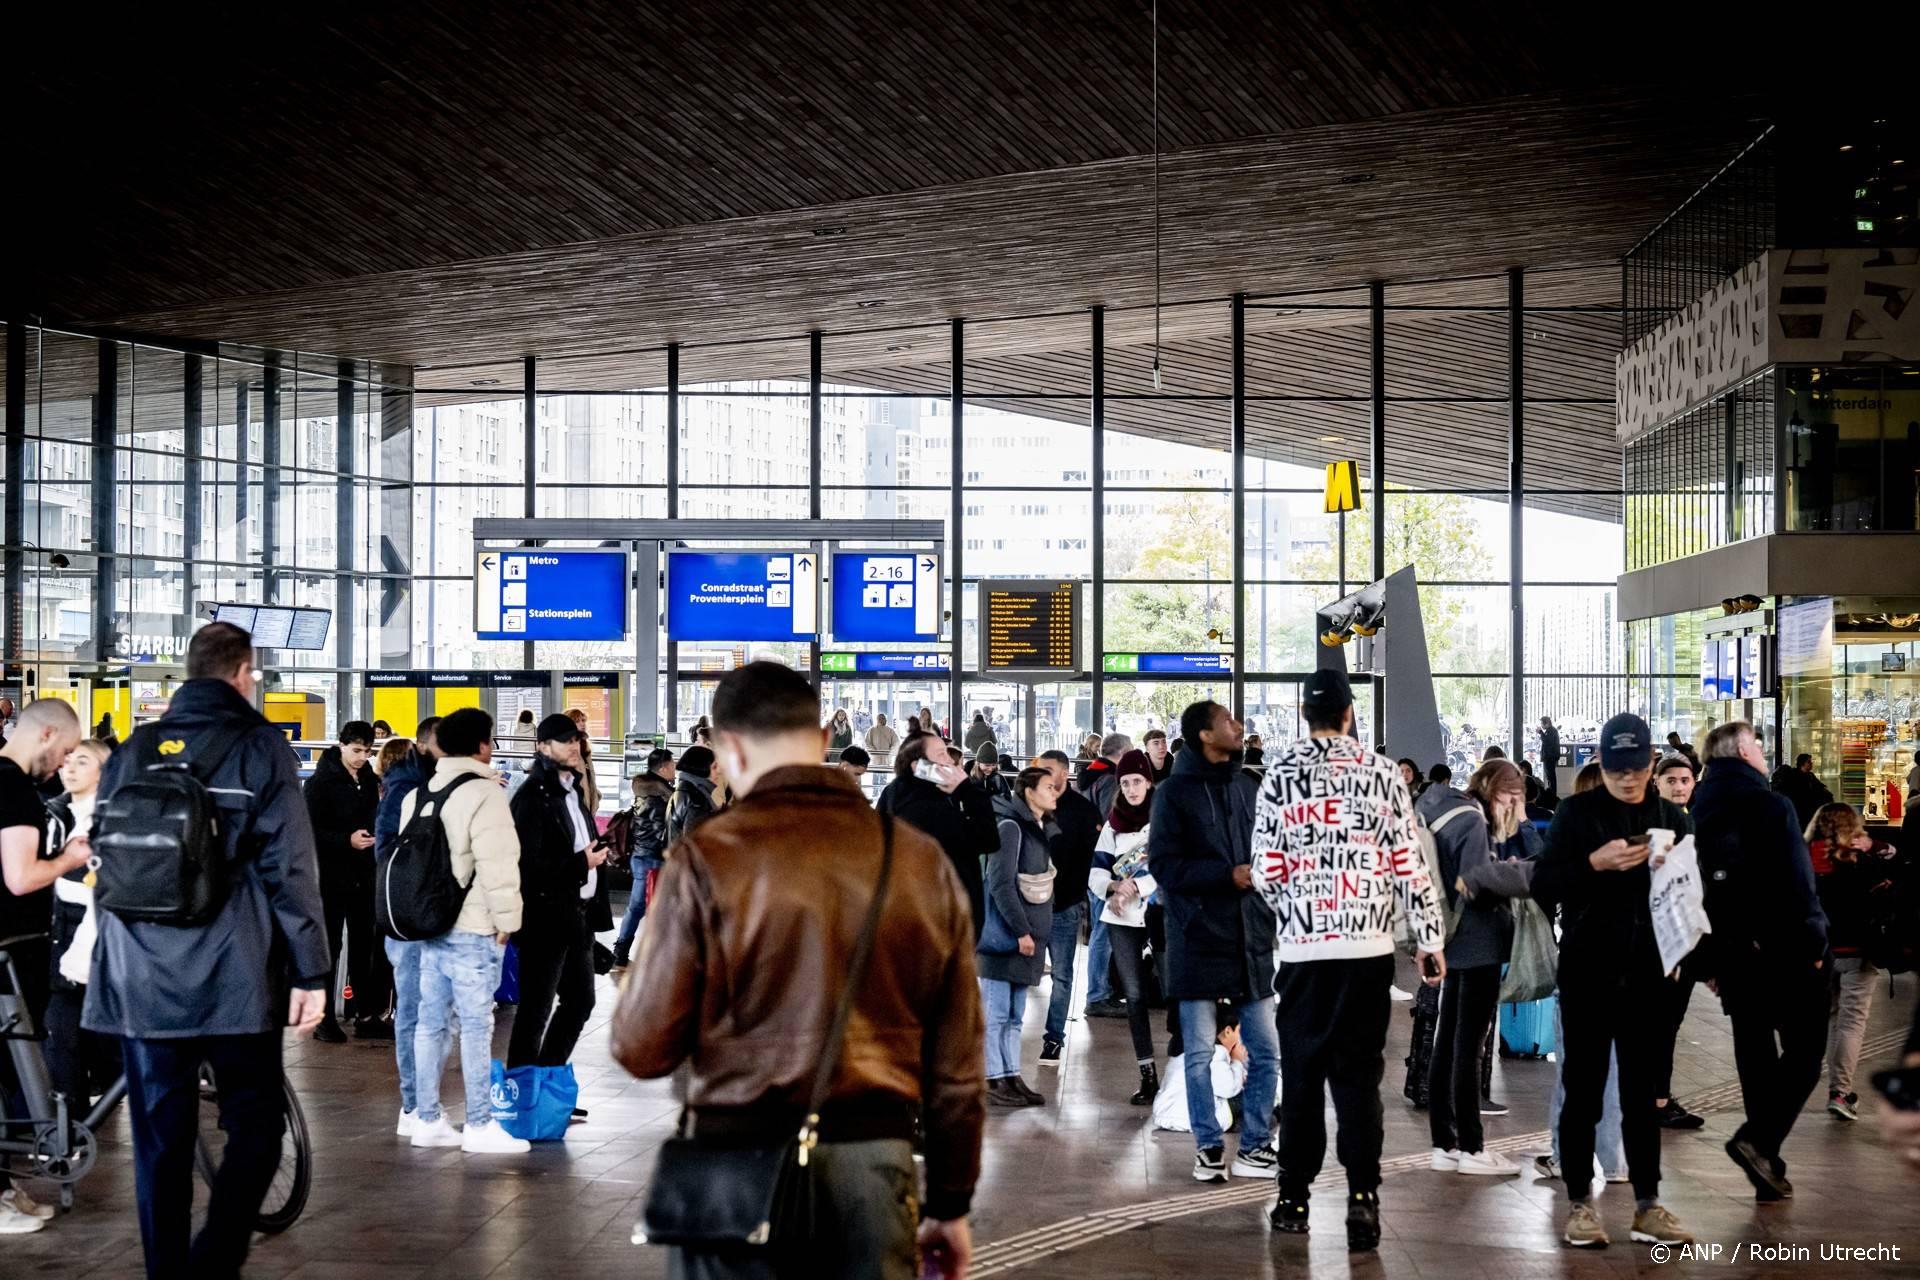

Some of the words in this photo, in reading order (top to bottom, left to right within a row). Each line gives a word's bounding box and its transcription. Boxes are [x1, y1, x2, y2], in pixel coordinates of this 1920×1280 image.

[529, 556, 559, 565] Metro
[701, 584, 764, 592] Conradstraat
[690, 594, 764, 605] Proveniersplein
[528, 608, 592, 620] Stationsplein
[1315, 777, 1370, 798] NIKE
[1302, 823, 1348, 846] NIKE
[1316, 912, 1366, 933] NIKE
